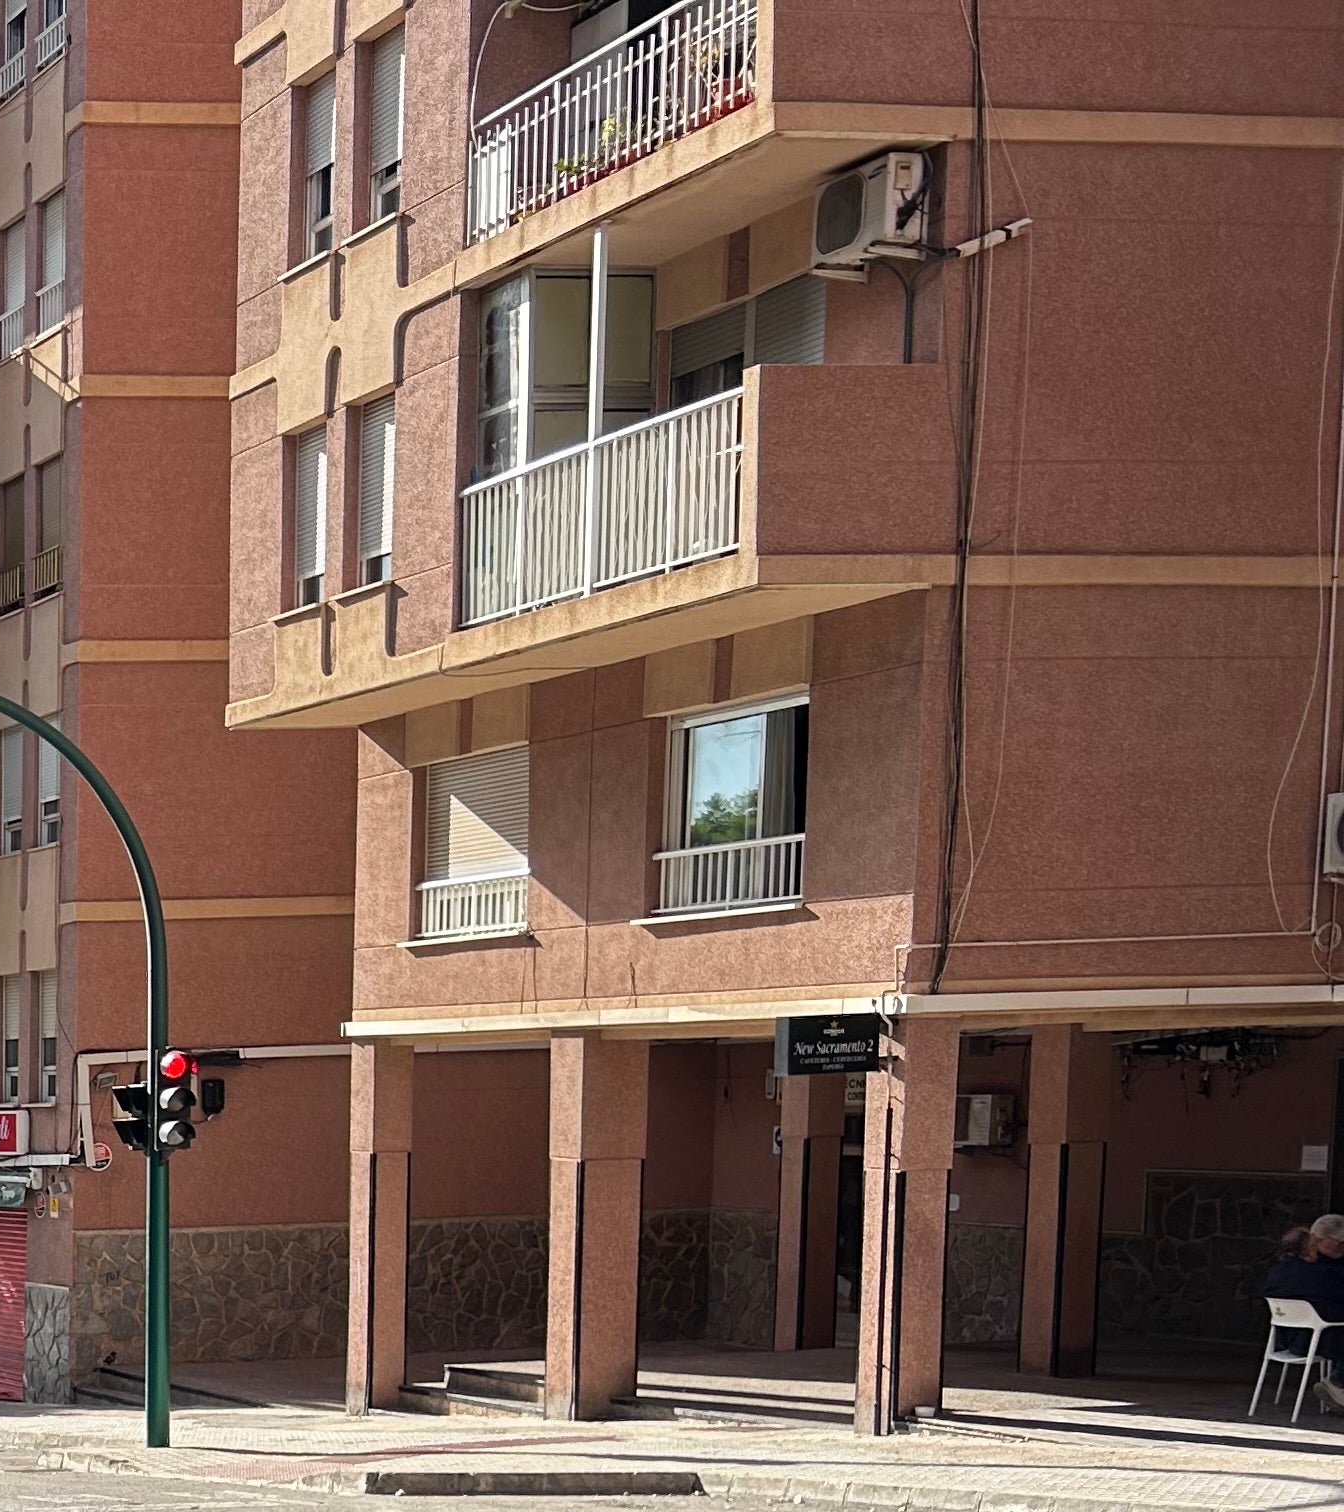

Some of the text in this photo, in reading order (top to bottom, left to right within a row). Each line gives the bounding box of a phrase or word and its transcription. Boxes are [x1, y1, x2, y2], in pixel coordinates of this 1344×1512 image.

[793, 1039, 874, 1055] New Sacramento 2
